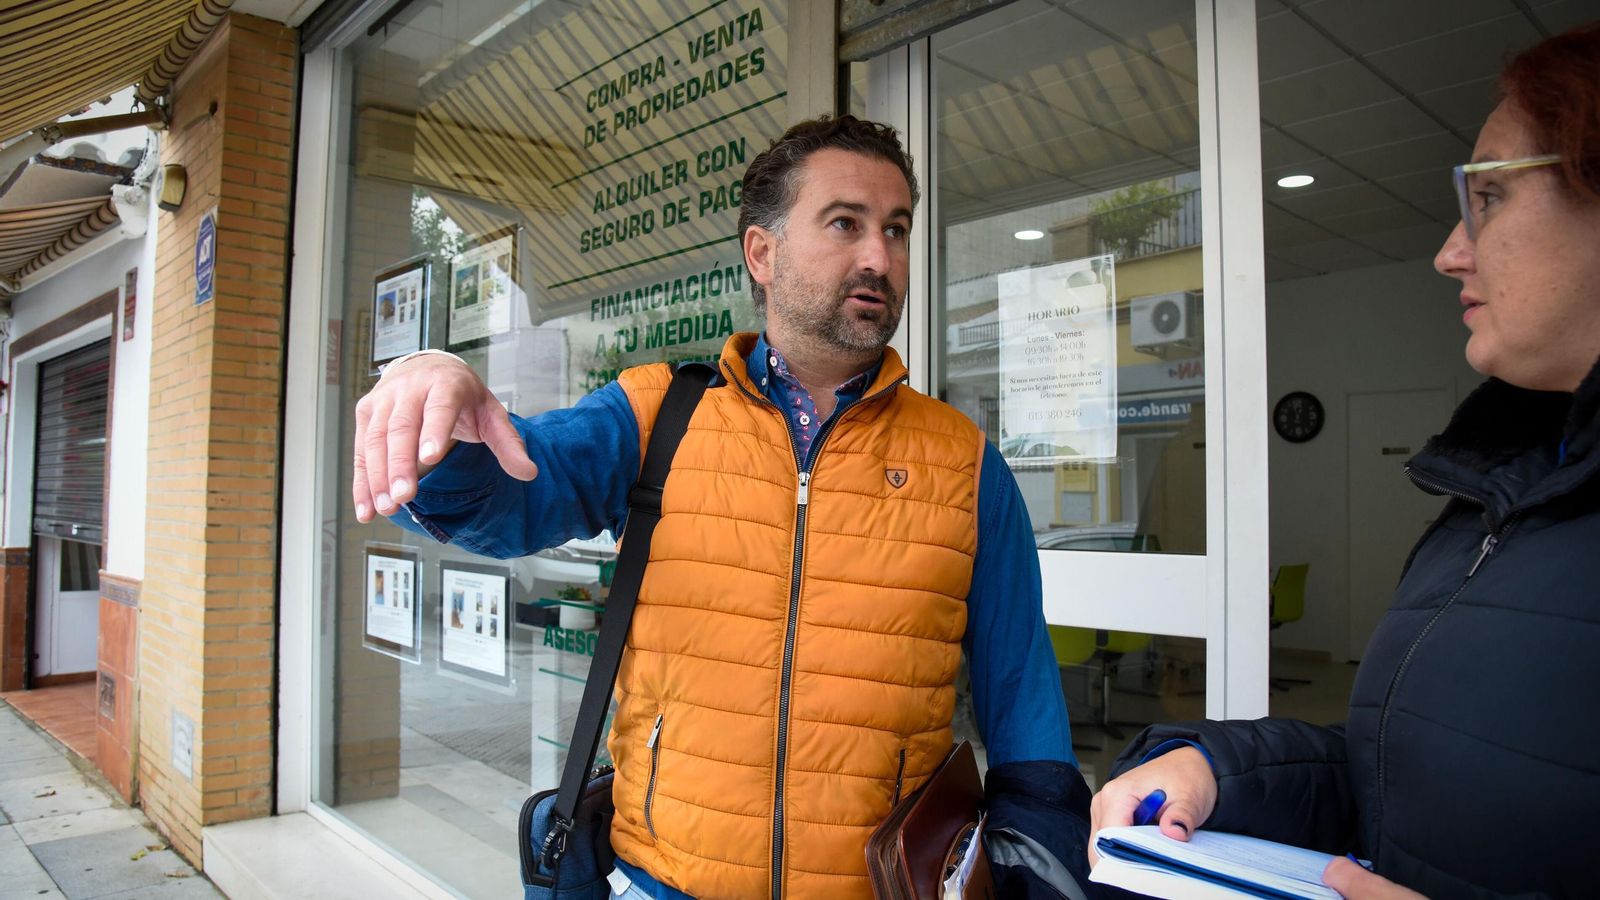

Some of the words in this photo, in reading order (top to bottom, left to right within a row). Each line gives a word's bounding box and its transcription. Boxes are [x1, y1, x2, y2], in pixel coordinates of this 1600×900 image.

[586, 55, 666, 114] COMPRA
[688, 8, 764, 64] VENTA
[584, 119, 607, 149] DE
[613, 47, 765, 136] PROPIEDADES
[593, 159, 688, 214] ALQUILER
[696, 137, 745, 178] CON
[580, 209, 655, 253] SEGURO
[663, 196, 690, 228] DE
[699, 180, 743, 217] PAG
[591, 261, 742, 322] FINANCIACIÓN
[1028, 305, 1080, 321] HORARIO
[594, 334, 607, 359] A
[614, 326, 637, 354] TU
[645, 309, 733, 349] MEDIDA
[1027, 335, 1049, 344] Lunes
[1055, 330, 1086, 340] Viernes:
[543, 624, 599, 657] ASESO
